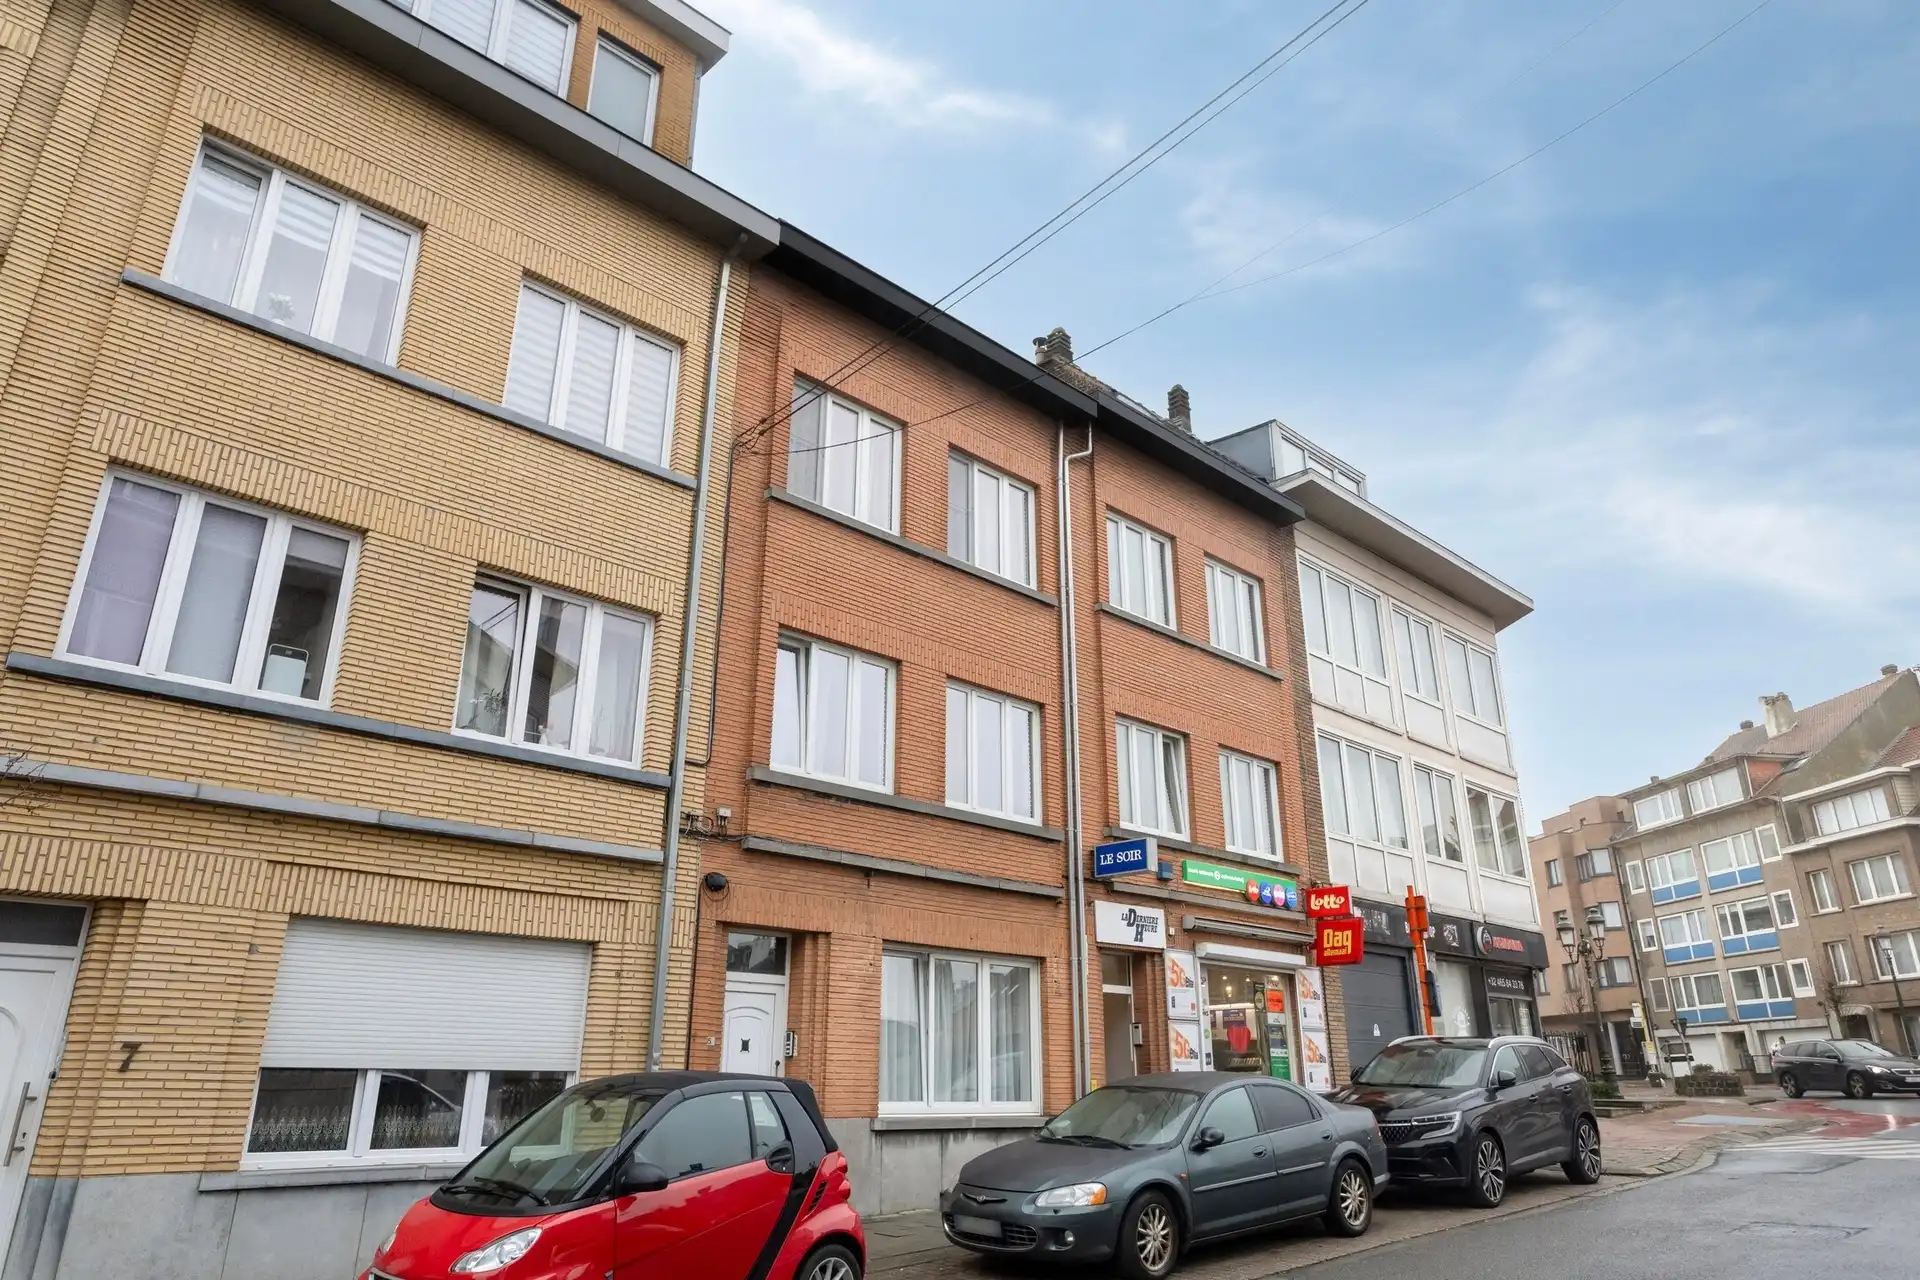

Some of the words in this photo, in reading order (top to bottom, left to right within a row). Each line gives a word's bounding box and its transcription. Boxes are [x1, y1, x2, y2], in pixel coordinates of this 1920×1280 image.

[1100, 853, 1114, 865] LE
[1116, 849, 1142, 863] SOIR
[1121, 912, 1128, 922] LA
[1133, 923, 1158, 943] HEURE
[1323, 928, 1352, 955] Dag
[117, 1041, 142, 1073] 7
